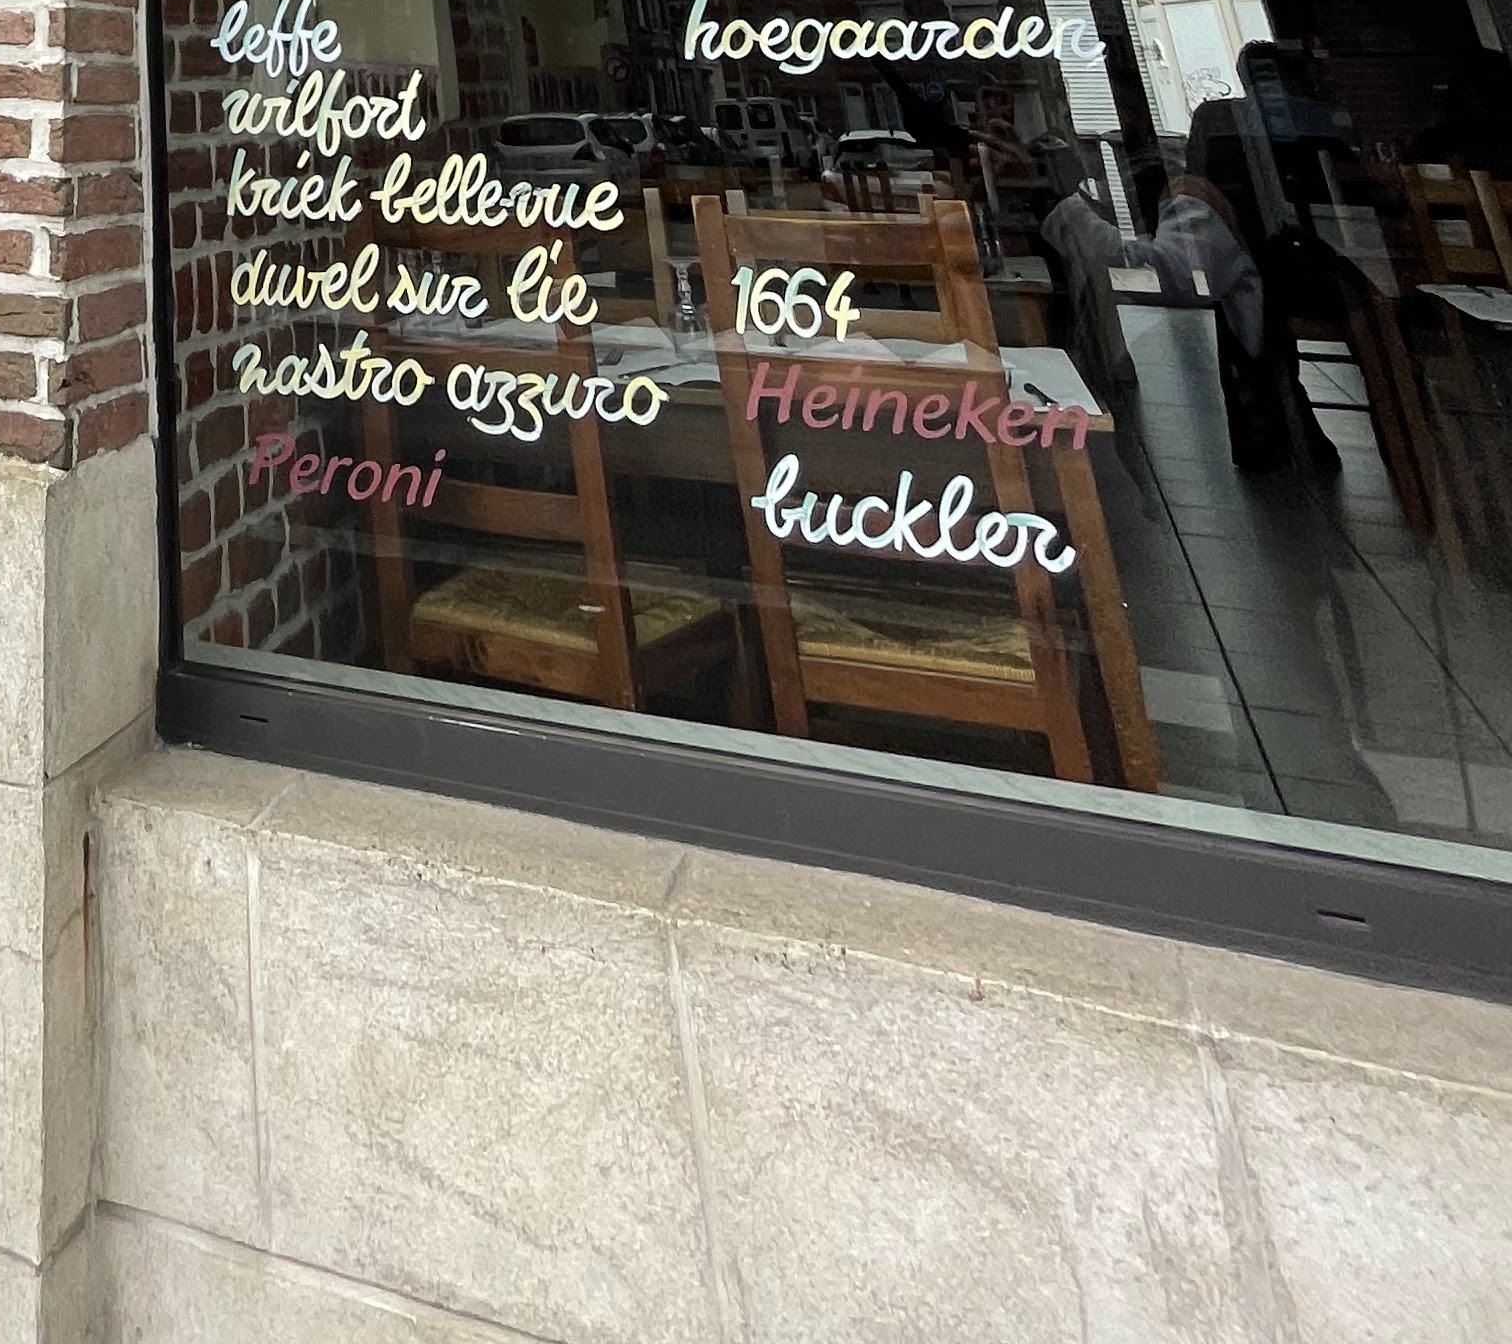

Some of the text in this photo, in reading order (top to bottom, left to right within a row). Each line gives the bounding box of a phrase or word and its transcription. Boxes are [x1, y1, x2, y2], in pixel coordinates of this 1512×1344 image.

[221, 67, 427, 157] wilfort
[226, 148, 363, 223] kriek
[231, 238, 600, 325] duvel sur lie
[731, 265, 861, 343] 1664
[232, 329, 670, 442] nastro azzuro
[745, 361, 1090, 450] Heineken
[248, 432, 448, 508] Peroni
[751, 452, 1077, 574] buckler
